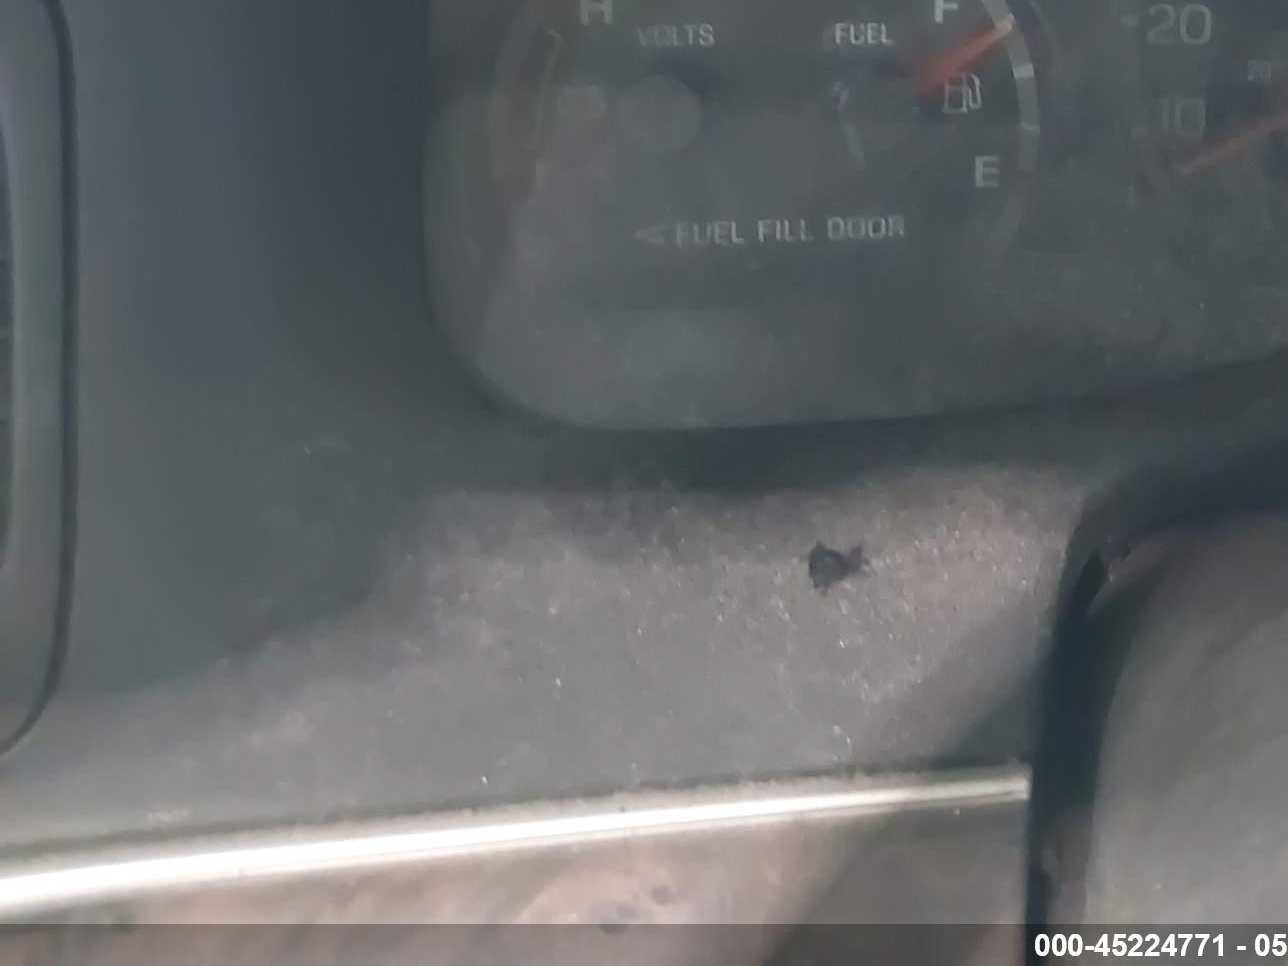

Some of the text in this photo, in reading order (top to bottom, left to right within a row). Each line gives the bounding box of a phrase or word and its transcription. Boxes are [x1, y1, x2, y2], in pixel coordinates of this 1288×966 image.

[636, 24, 718, 48] VOLTS
[833, 23, 896, 47] FUEL
[1145, 2, 1213, 46] 20
[1157, 94, 1207, 138] 10
[974, 154, 1000, 189] E
[675, 215, 906, 248] FUEL FILL DOOR
